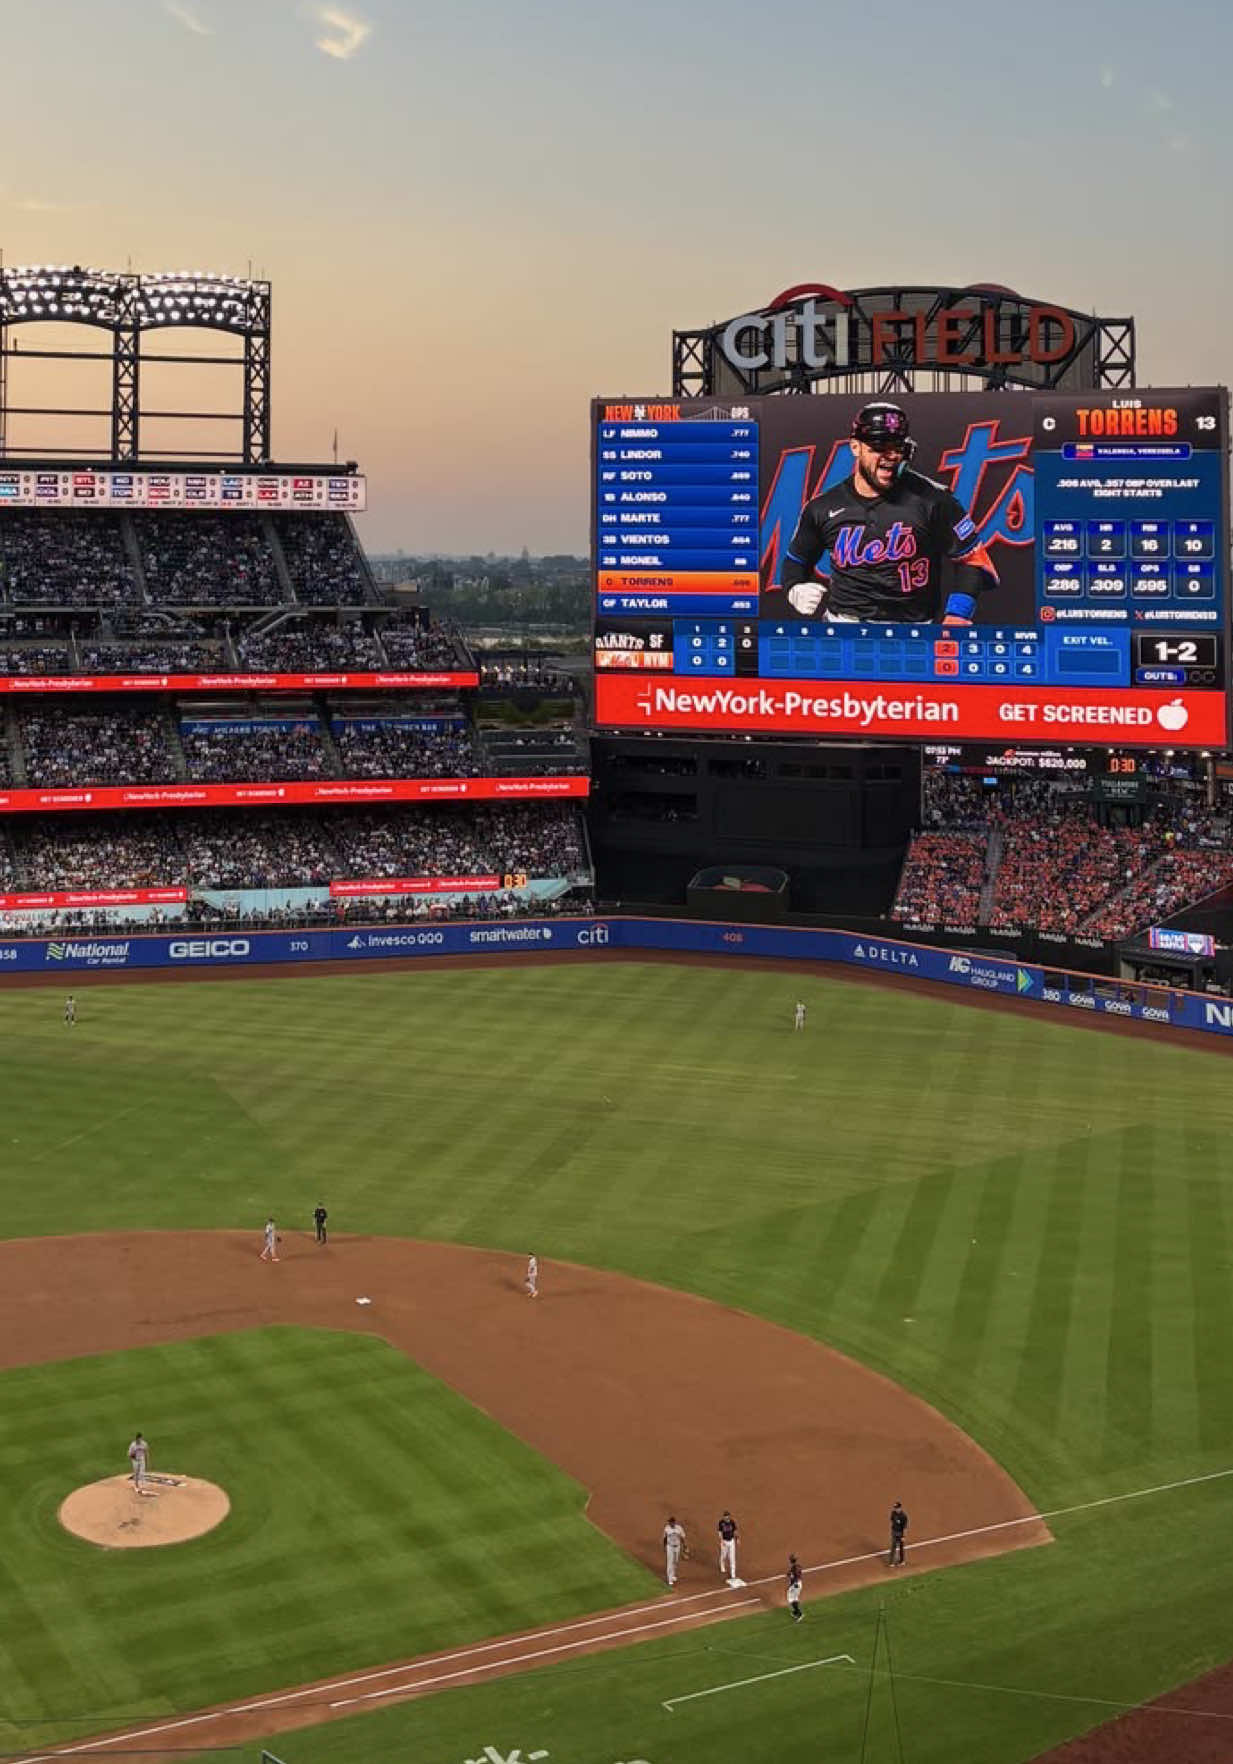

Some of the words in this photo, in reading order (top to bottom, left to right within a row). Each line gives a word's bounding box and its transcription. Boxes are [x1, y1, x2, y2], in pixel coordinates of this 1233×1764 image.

[873, 307, 1075, 366] FIELD
[1112, 399, 1142, 409] LUIS
[605, 405, 633, 421] NEW
[647, 405, 681, 421] YORK
[1042, 418, 1056, 430] C
[1076, 408, 1178, 435] TORRENS
[1196, 416, 1217, 430] 13
[620, 428, 658, 438] NIMMO
[620, 450, 662, 459] LINDOR
[620, 471, 652, 480] SOTO
[1146, 479, 1173, 488] OVER
[1173, 479, 1200, 488] LAST
[620, 492, 667, 502] ALONSO
[1093, 489, 1122, 497] EIGHT
[1123, 489, 1163, 498] STARTS
[620, 513, 660, 523] MARTE
[620, 534, 670, 544] VIENTOS
[831, 522, 917, 568] Mets
[1101, 539, 1112, 551] 2
[1185, 540, 1202, 551] 10
[899, 557, 930, 592] 13
[621, 577, 674, 587] TORRENS
[1090, 579, 1124, 592] .309
[1189, 580, 1200, 592] 0
[621, 598, 668, 609] TAYLOR
[649, 634, 665, 648] SF
[692, 637, 702, 648] 0
[717, 638, 727, 648] 2
[742, 638, 752, 649] 0
[968, 643, 978, 654] 3
[995, 644, 1005, 654] 0
[1021, 644, 1032, 655] 4
[1063, 636, 1088, 645] EXIT
[1090, 636, 1113, 645] VEL.
[1154, 641, 1198, 661] 1-2
[692, 656, 702, 665] 0
[717, 656, 727, 666] 0
[968, 662, 979, 673] 0
[995, 663, 1005, 673] 0
[1021, 664, 1032, 674] 4
[655, 687, 959, 726] NewYork-Presbyterian
[999, 702, 1038, 722] GET
[1043, 704, 1152, 725] SCREENED
[985, 756, 1034, 767] JACKPOT:
[470, 928, 541, 943] smartwater
[64, 942, 130, 959] National
[169, 940, 250, 958] GEICO
[289, 942, 309, 952] 370
[868, 945, 919, 967] DELTA
[970, 967, 1015, 983] HAUGLAND
[970, 975, 999, 988] GROUP
[1042, 988, 1062, 1002] 380
[1205, 1002, 1233, 1028] N
